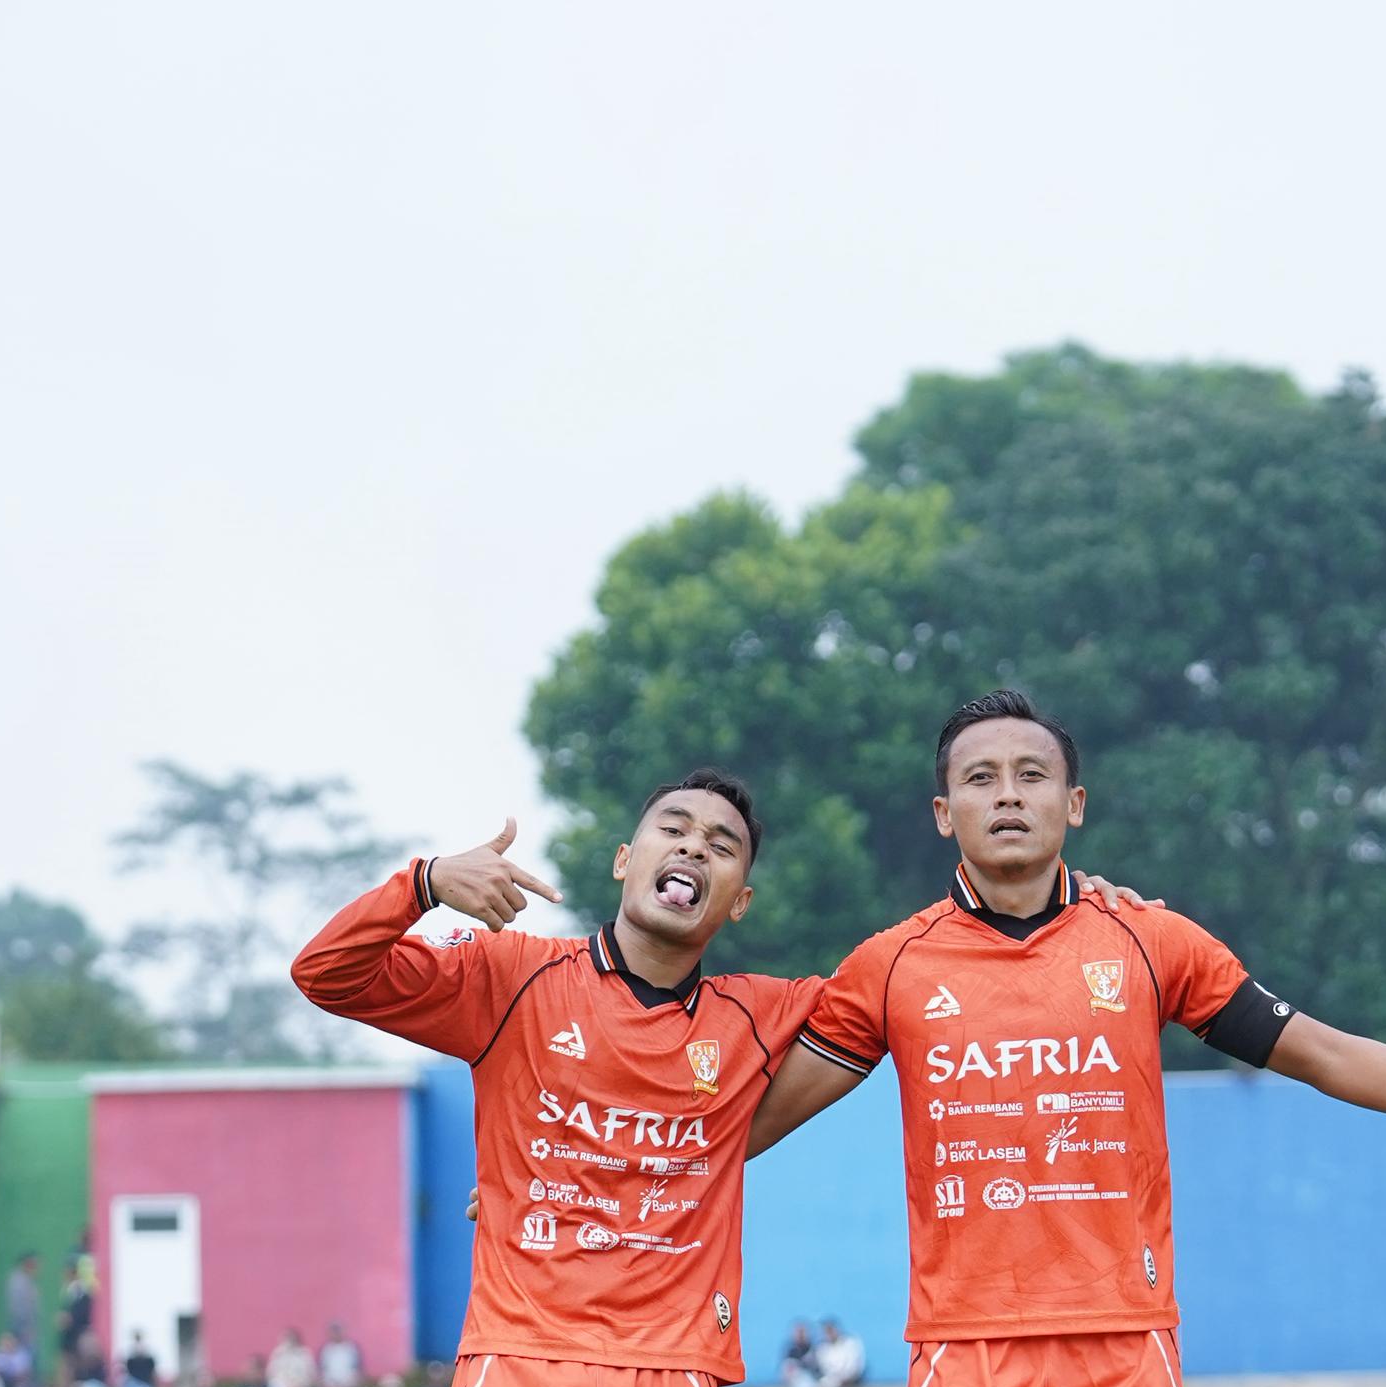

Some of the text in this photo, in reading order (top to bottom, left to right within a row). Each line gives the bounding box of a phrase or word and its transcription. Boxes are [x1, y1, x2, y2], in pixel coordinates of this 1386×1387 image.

[1085, 964, 1119, 976] PSIR
[924, 1008, 961, 1020] ARAFS
[548, 1043, 586, 1060] ARAFS
[689, 1046, 717, 1057] PSIR
[926, 1035, 1121, 1083] SAFRIA
[948, 1103, 1023, 1116] BANK REMBANG
[1070, 1097, 1124, 1107] BANYUMILI
[537, 1089, 709, 1149] SAFRIA
[949, 1140, 977, 1150] PT BPR
[1061, 1138, 1126, 1154] Bank Jateng
[554, 1149, 627, 1168] BANK REMBANG
[950, 1147, 1026, 1162] BKK LASEM
[547, 1181, 579, 1192] PT BPR
[935, 1180, 965, 1207] SLI
[548, 1189, 620, 1212] BKK LASEM
[653, 1200, 678, 1212] Bank
[522, 1215, 557, 1241] SLI
